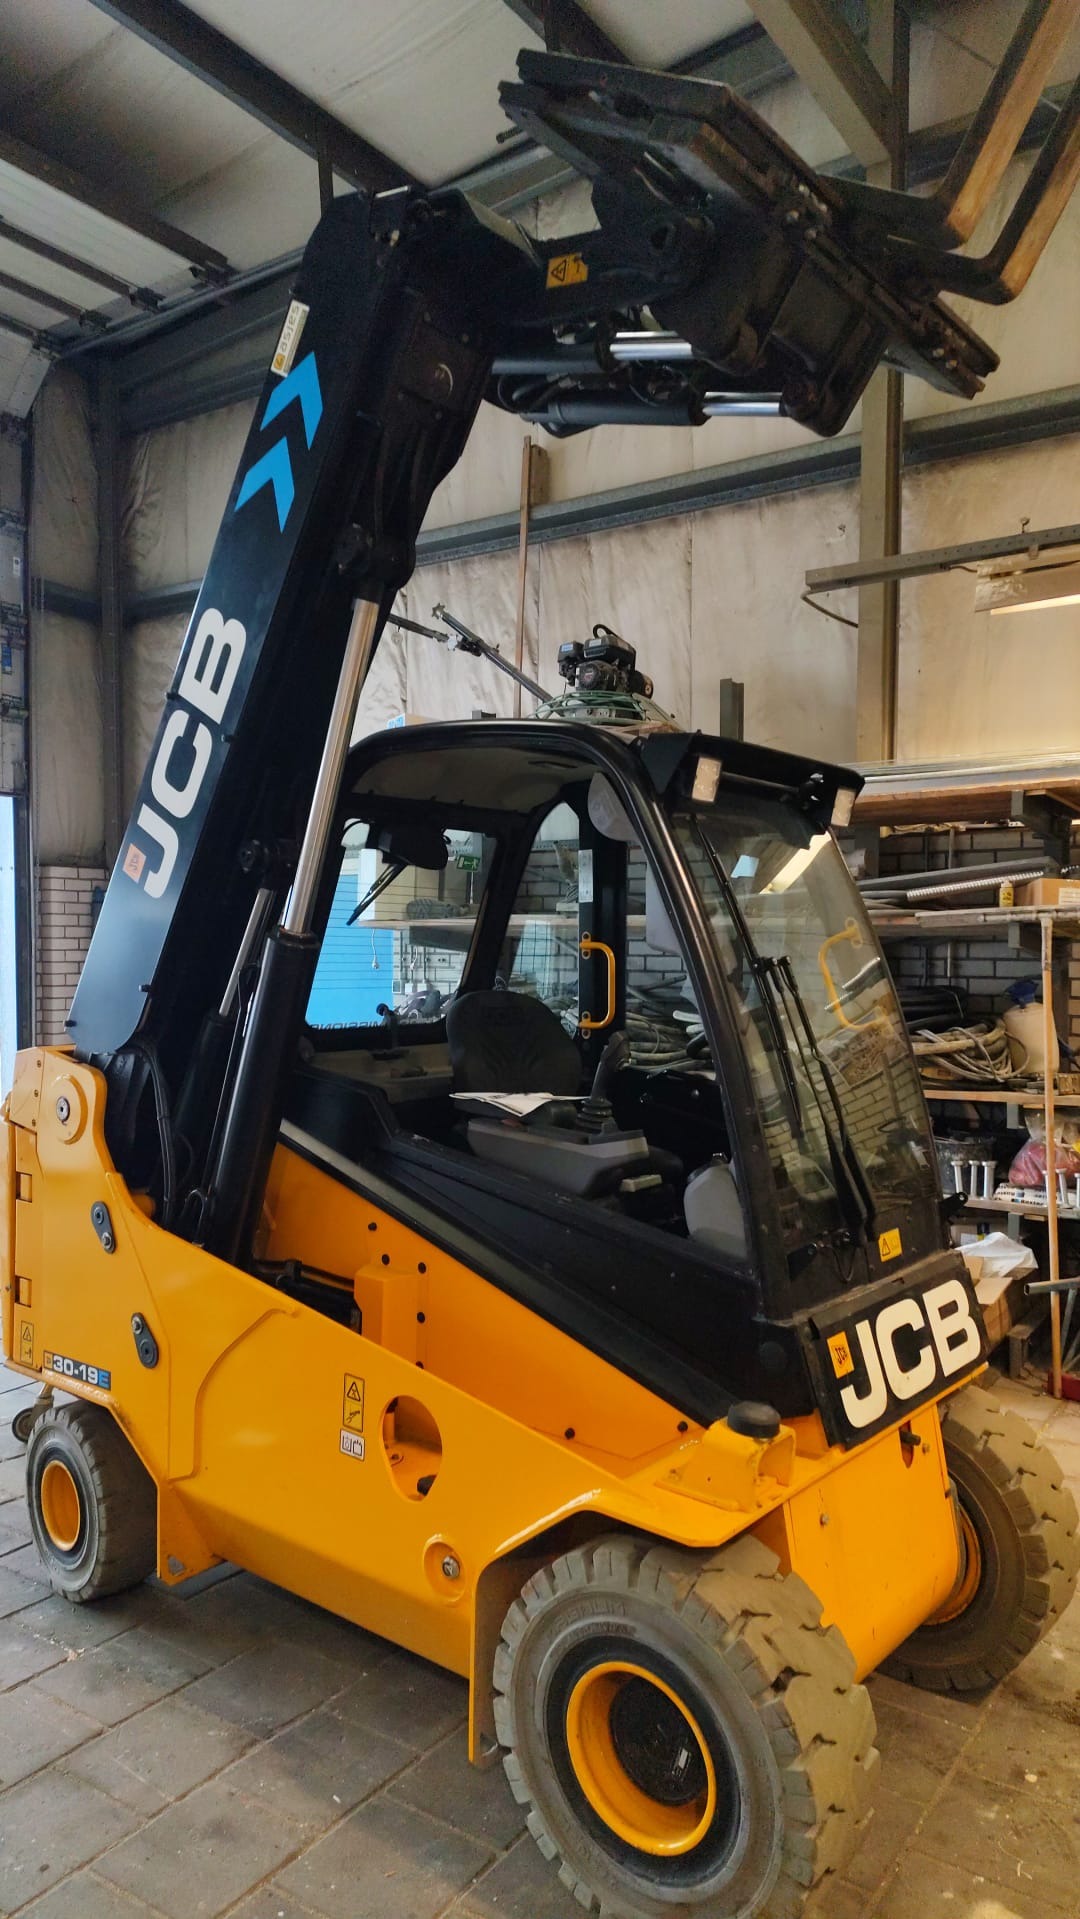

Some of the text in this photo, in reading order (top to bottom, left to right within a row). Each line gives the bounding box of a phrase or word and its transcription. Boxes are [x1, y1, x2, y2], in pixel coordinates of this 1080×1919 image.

[137, 608, 247, 899] JCB
[53, 1354, 110, 1389] 30-19E
[840, 1279, 981, 1429] JCB
